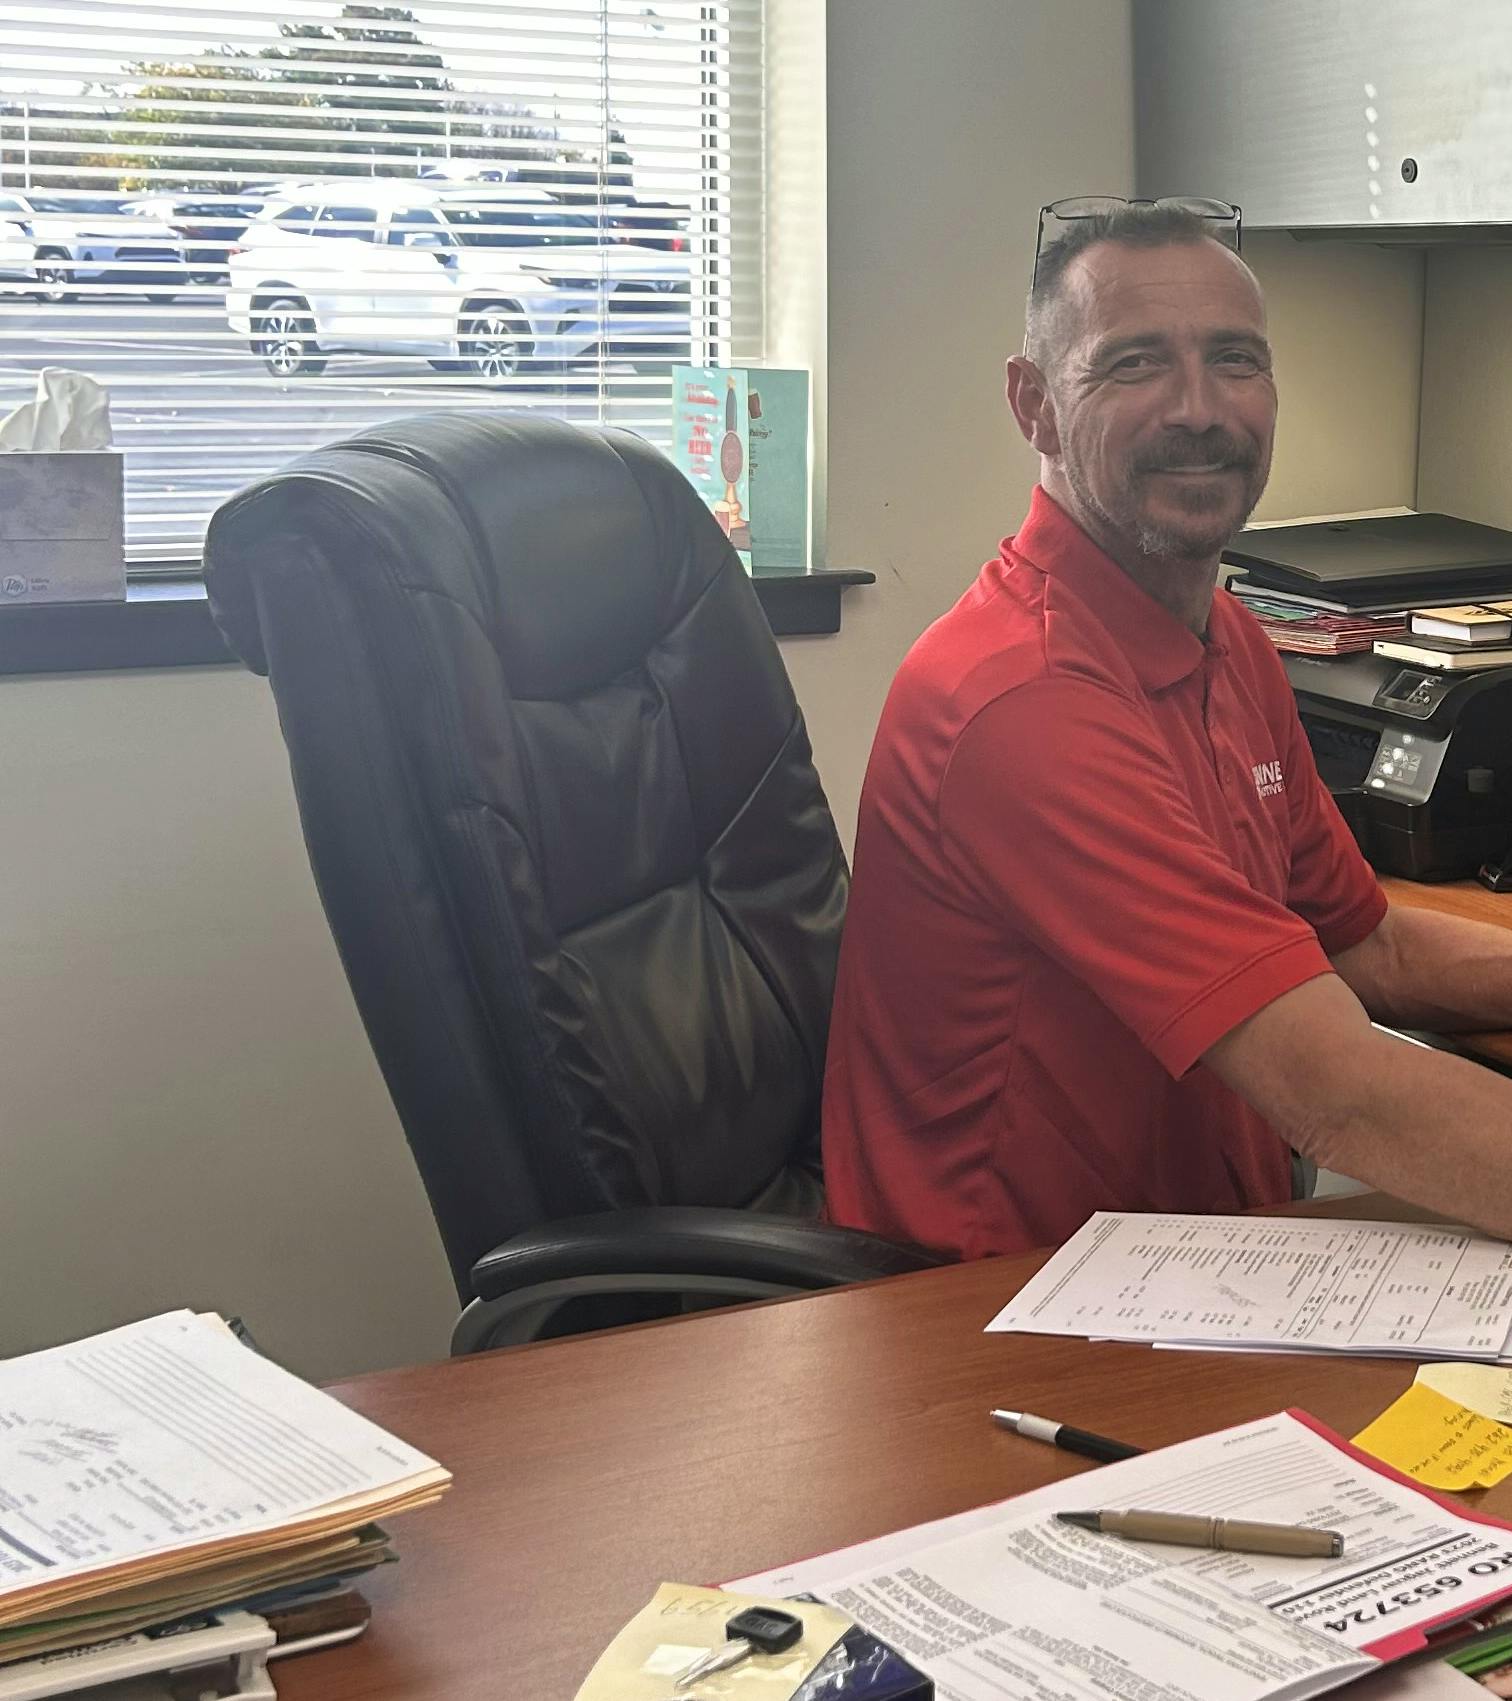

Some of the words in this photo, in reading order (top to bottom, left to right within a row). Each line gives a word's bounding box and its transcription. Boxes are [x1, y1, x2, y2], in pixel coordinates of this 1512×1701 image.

[1437, 1542, 1499, 1570] Bennett
[1318, 1571, 1392, 1600] Defender
[1382, 1567, 1434, 1591] Jaguar
[1324, 1576, 1462, 1632] 653724
[1336, 1588, 1379, 1608] Land
